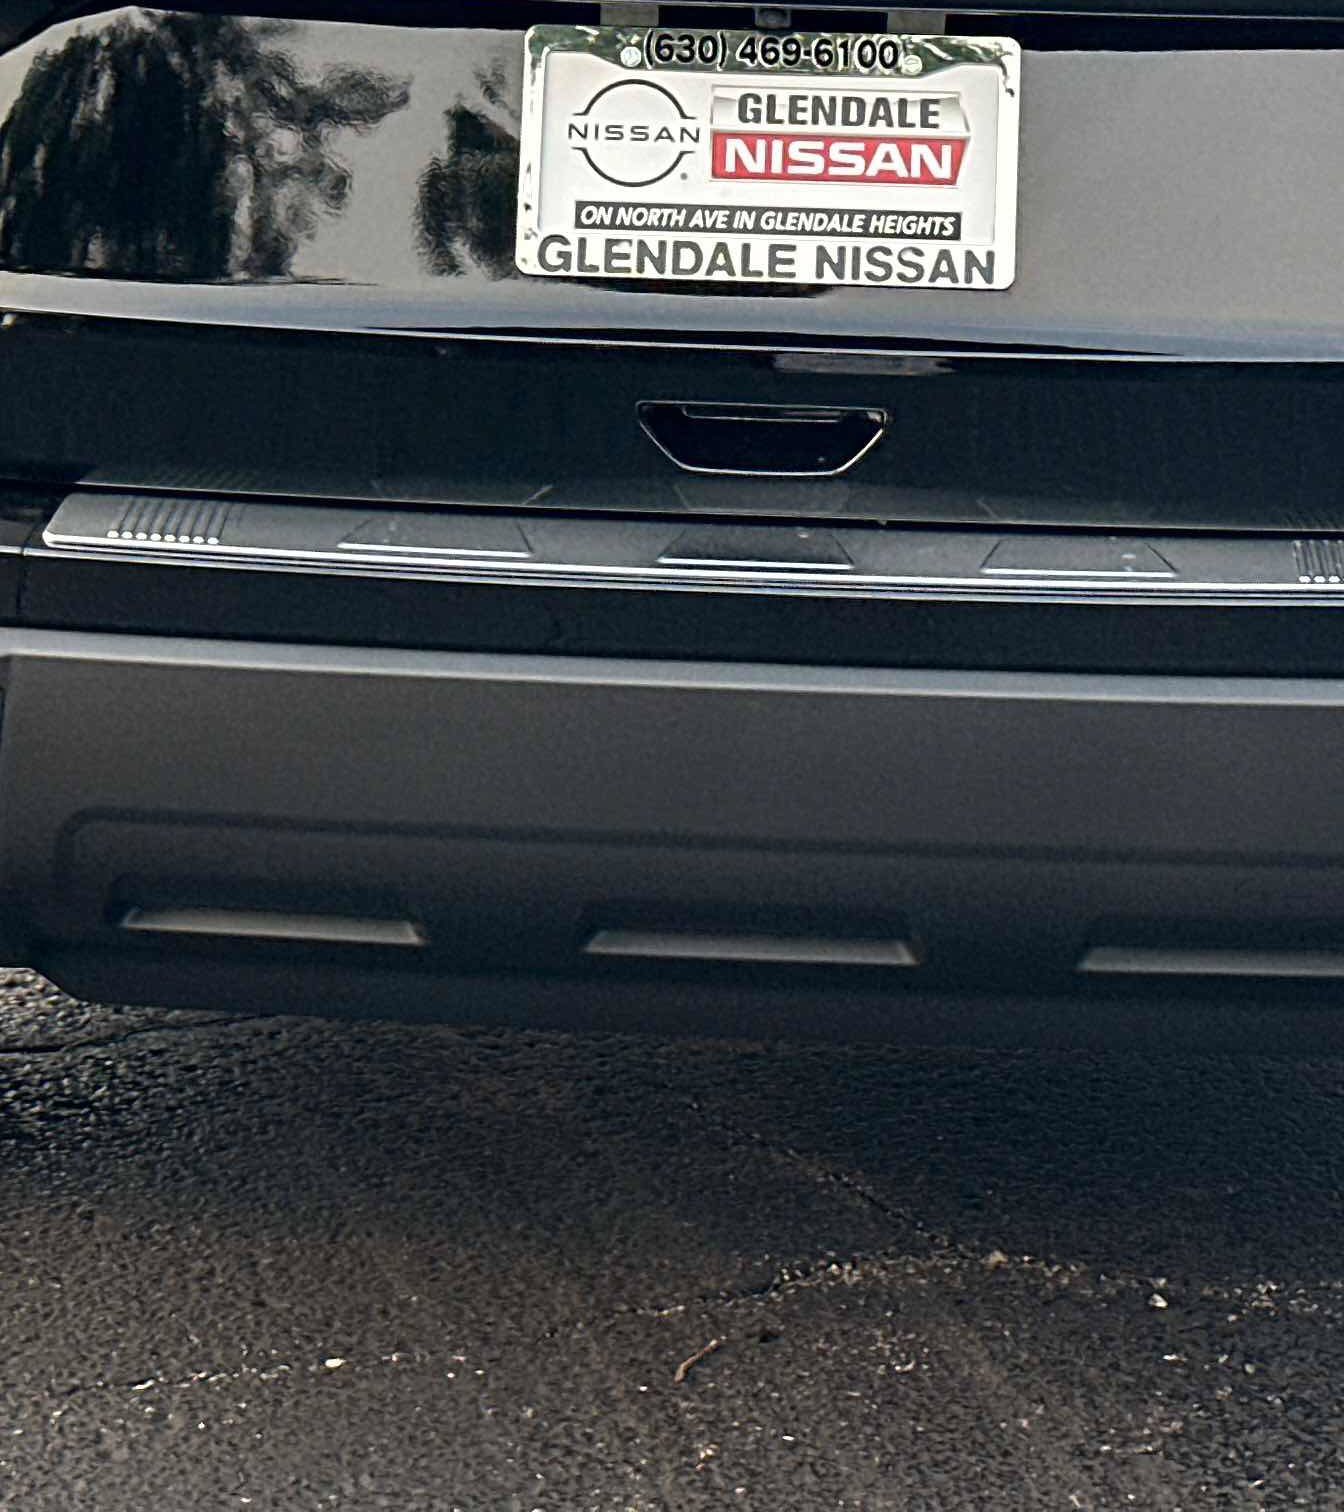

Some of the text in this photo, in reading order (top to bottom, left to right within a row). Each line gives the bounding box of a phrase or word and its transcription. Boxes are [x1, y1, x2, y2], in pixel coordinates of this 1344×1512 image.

[644, 29, 901, 71] (630) 469-6100
[737, 92, 941, 129] GLENDALE
[567, 122, 701, 144] NISSAN
[723, 138, 954, 180] NISSAN
[580, 205, 956, 236] ON NORTH AVE IN GLENDALE HEIGHTS
[537, 233, 996, 285] GLENDALE NISSAN
